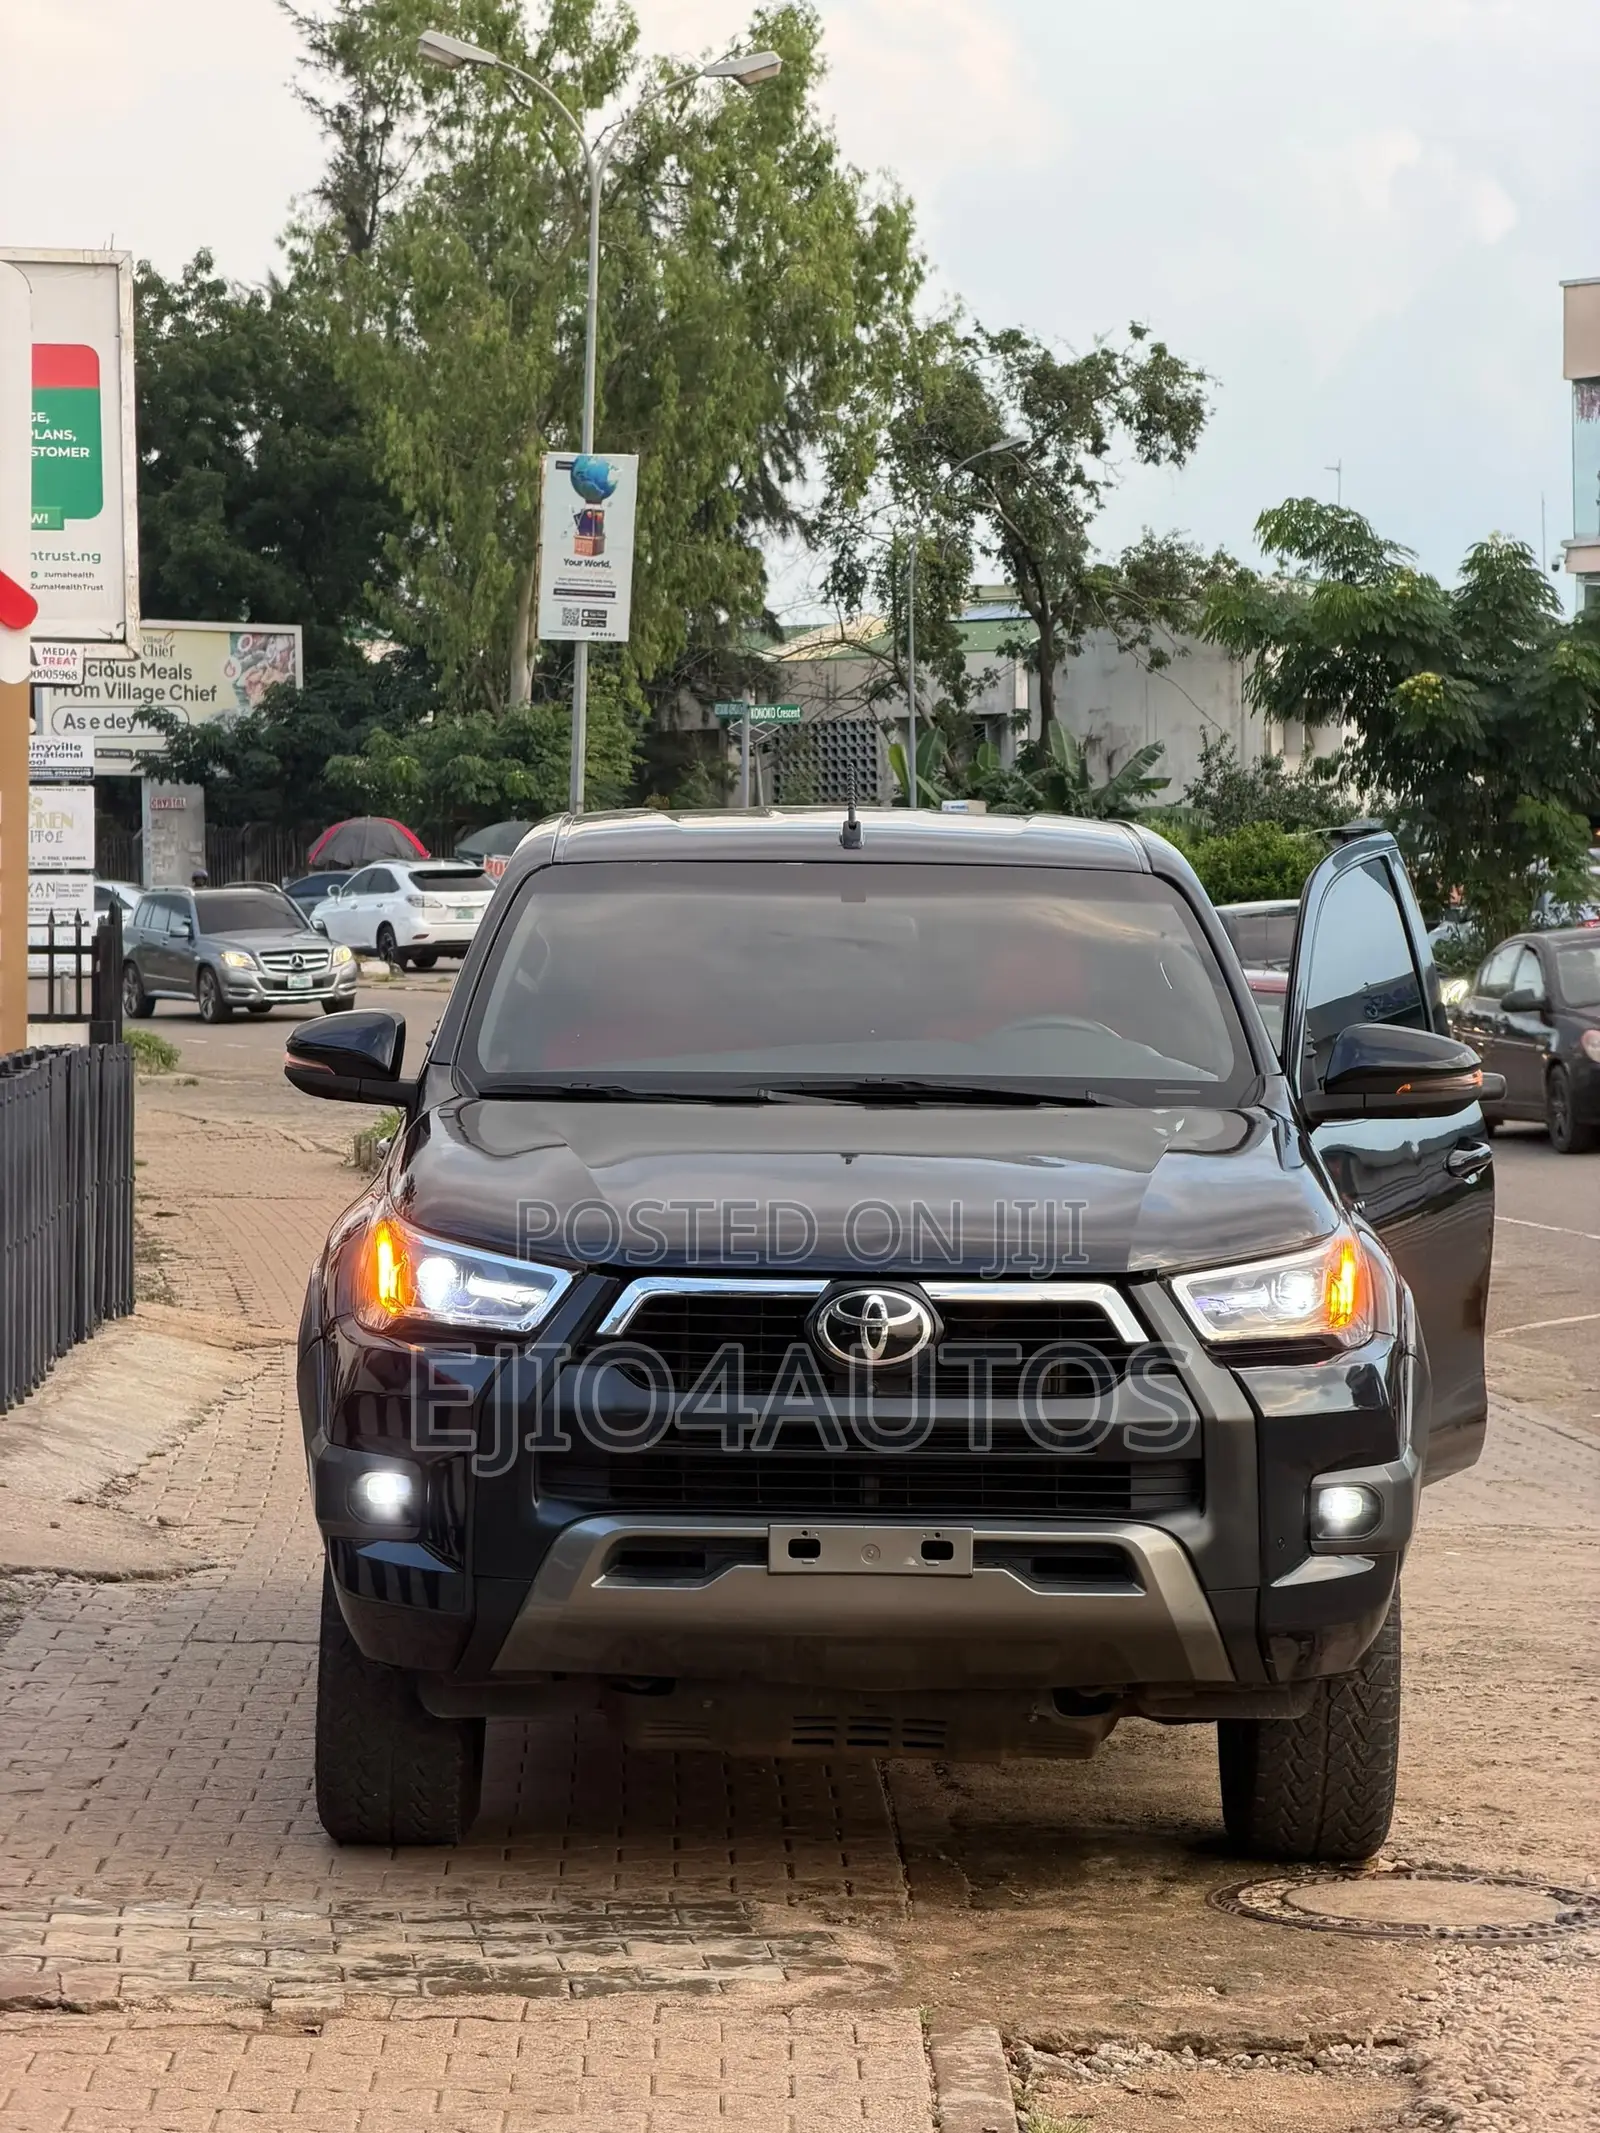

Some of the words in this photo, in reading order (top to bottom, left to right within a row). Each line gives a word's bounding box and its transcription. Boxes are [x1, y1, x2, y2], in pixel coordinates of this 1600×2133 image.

[32, 429, 77, 442] LANS,
[563, 558, 583, 567] Your
[44, 570, 95, 579] zumahealth
[42, 647, 77, 656] MEDIA
[42, 656, 78, 665] TREAT
[140, 662, 192, 680] Meals
[104, 681, 165, 704] Village
[169, 683, 218, 702] Chief
[776, 706, 801, 718] Crescent
[63, 712, 86, 730] As
[90, 717, 101, 730] e
[103, 712, 138, 734] dey
[29, 742, 82, 754] inyville
[29, 751, 83, 759] rnational
